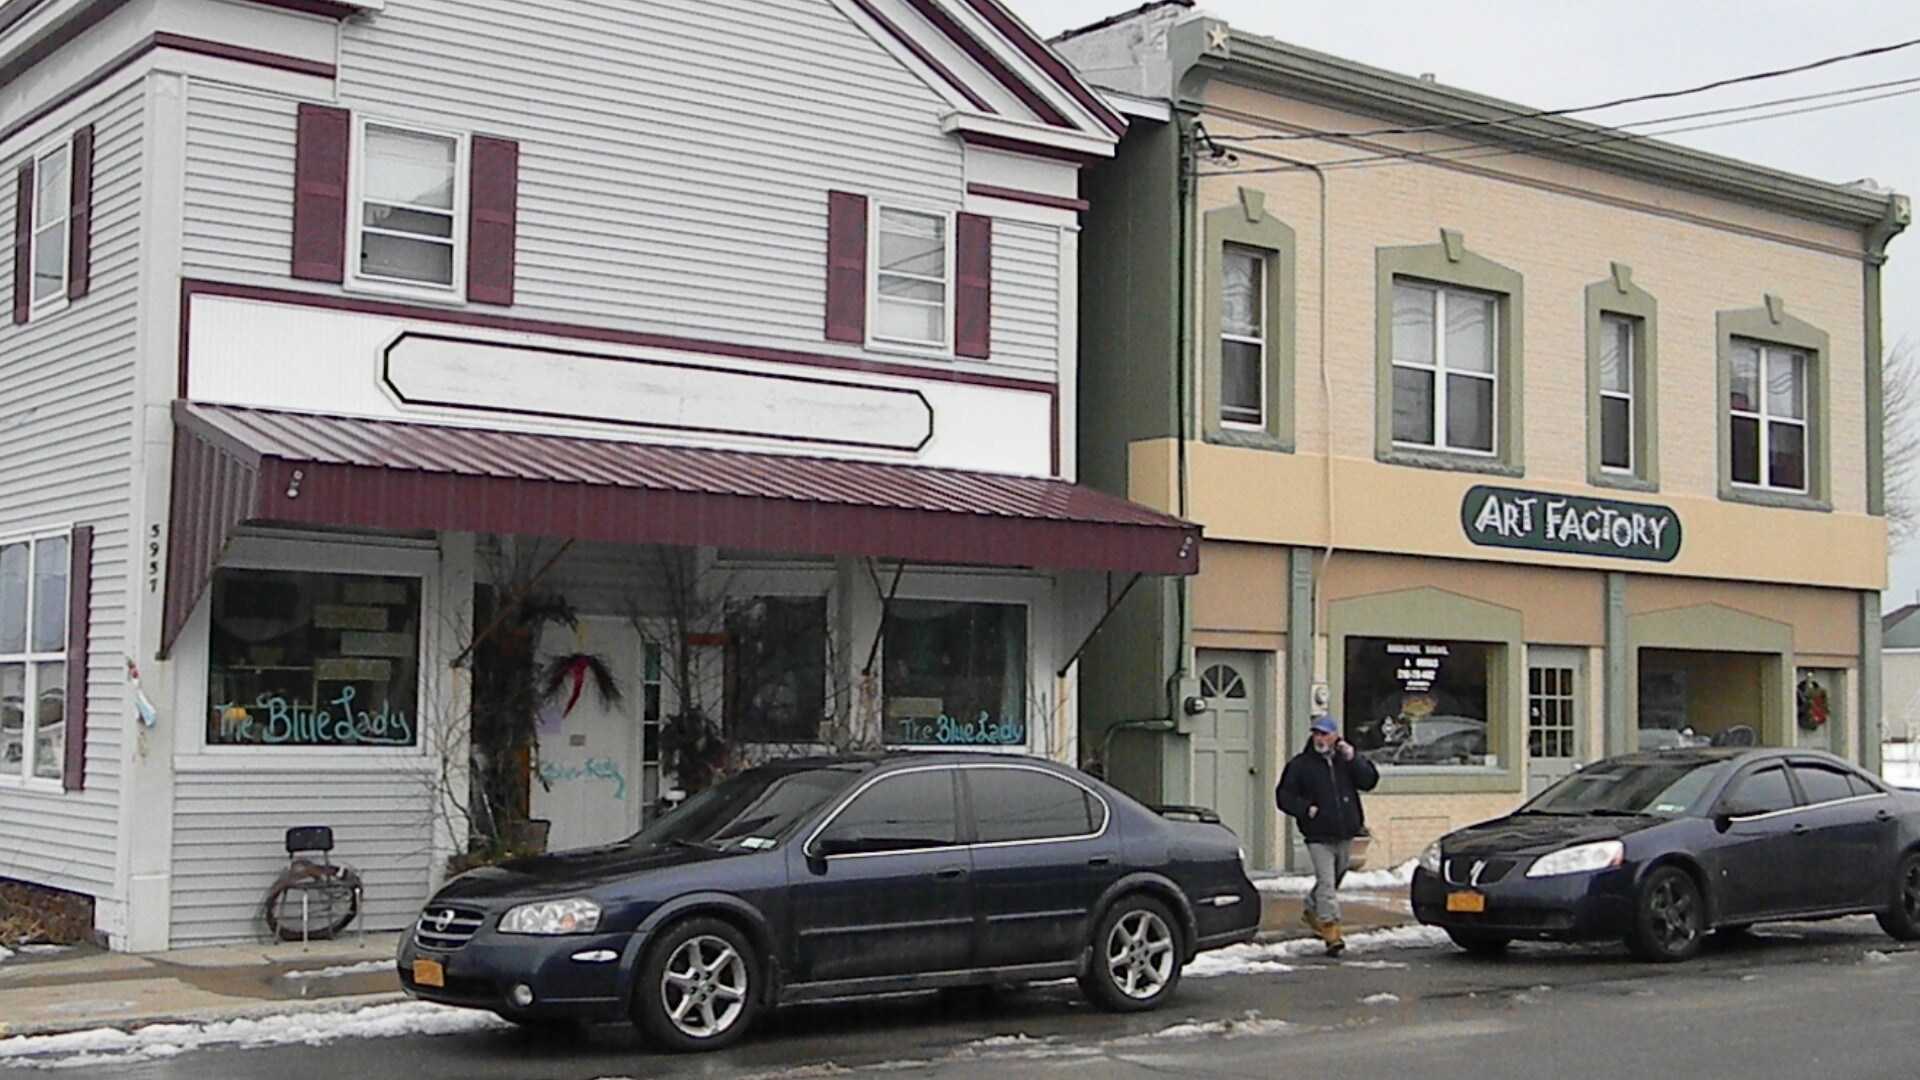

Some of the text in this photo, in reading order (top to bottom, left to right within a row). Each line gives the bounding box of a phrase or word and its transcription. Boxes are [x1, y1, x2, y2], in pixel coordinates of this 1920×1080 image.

[1475, 495, 1668, 550] ART FACTORY
[256, 692, 332, 742] Blue
[332, 686, 411, 744] Lady
[936, 714, 976, 743] Blue
[976, 710, 1023, 743] Lady
